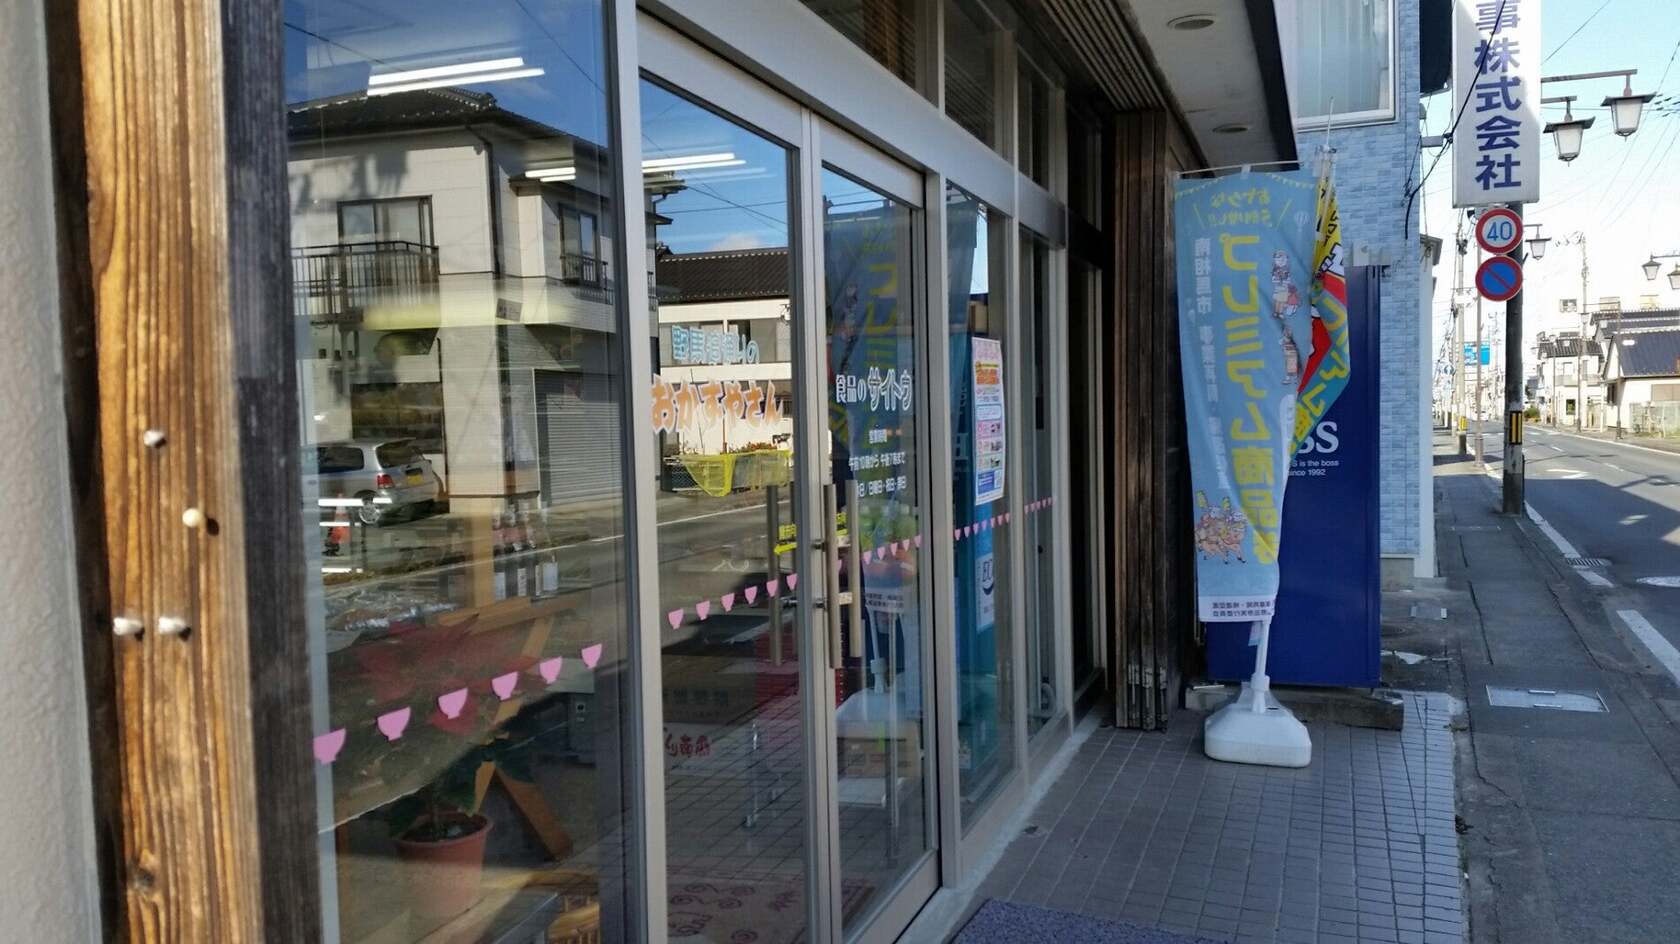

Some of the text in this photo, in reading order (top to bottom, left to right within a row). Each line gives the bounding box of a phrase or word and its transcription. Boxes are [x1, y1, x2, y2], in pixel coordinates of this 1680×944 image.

[1486, 221, 1513, 241] 40
[835, 366, 914, 412] 食品のサイトウ
[1321, 459, 1339, 467] boss
[1308, 468, 1327, 477] 1992
